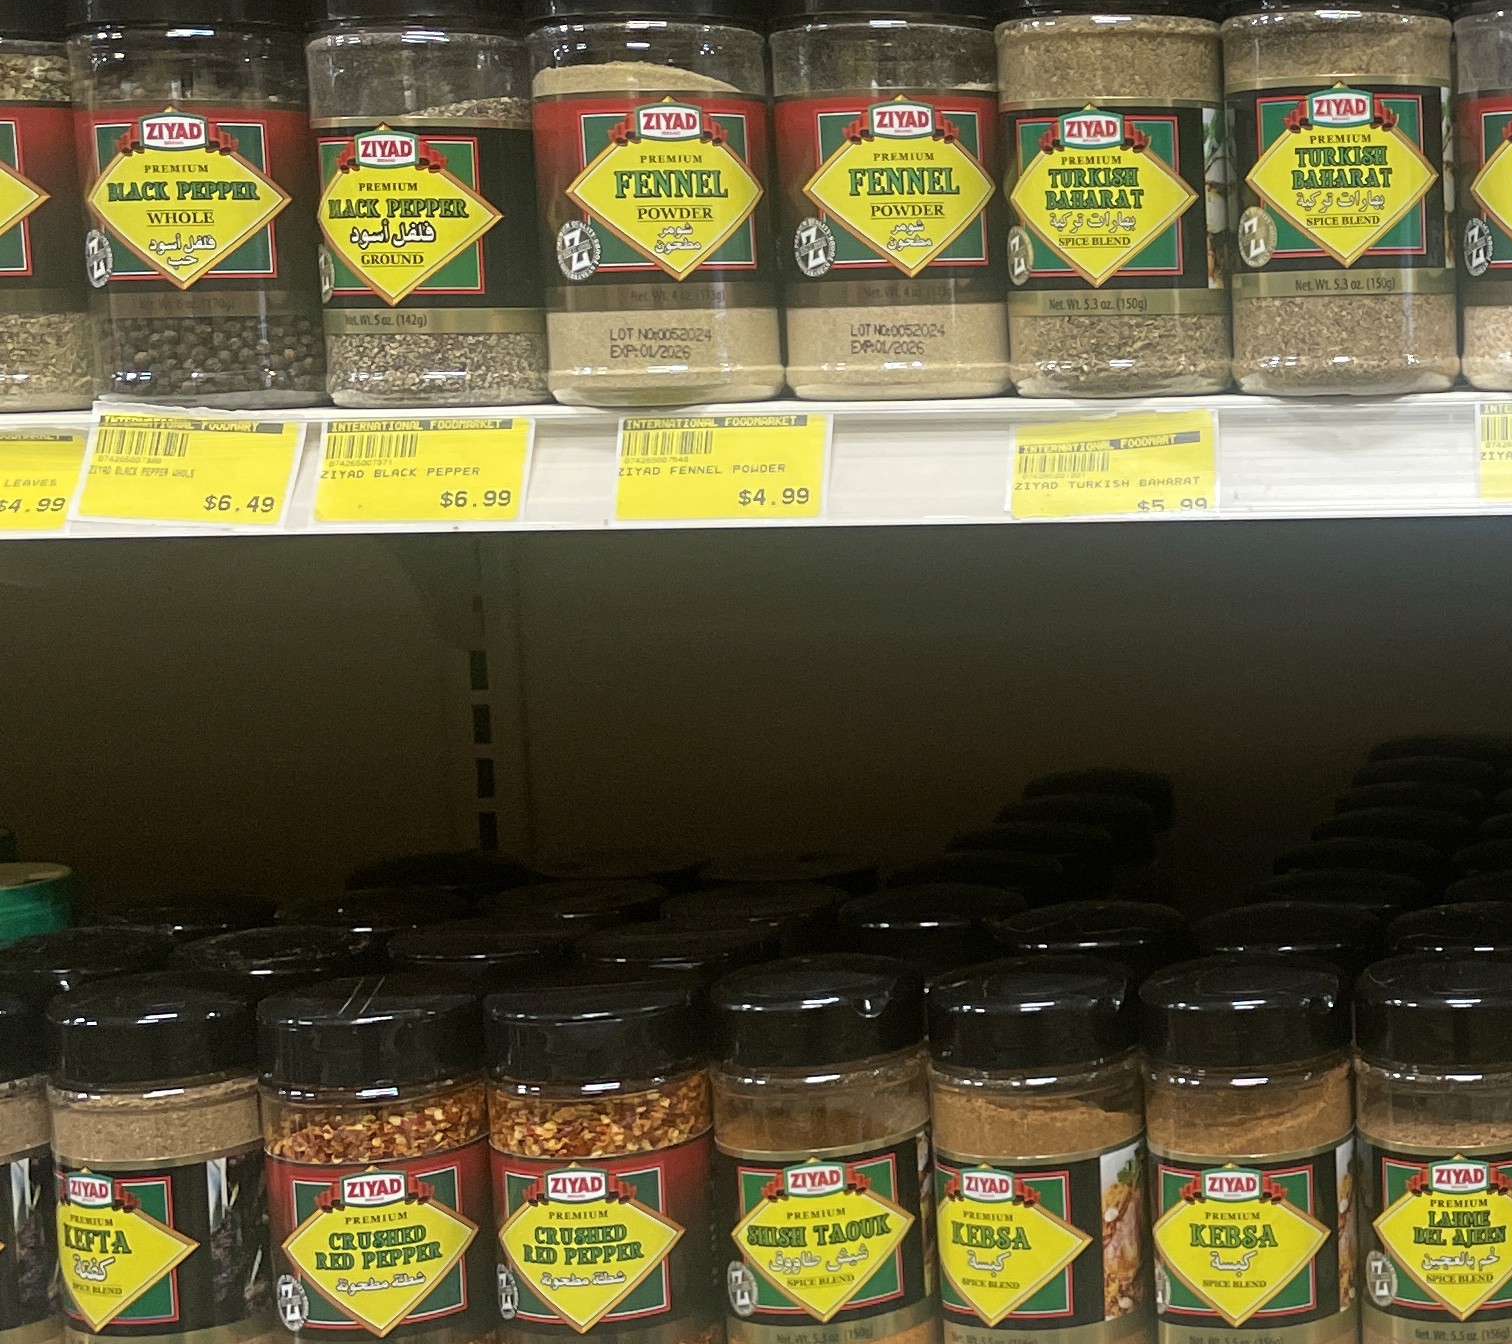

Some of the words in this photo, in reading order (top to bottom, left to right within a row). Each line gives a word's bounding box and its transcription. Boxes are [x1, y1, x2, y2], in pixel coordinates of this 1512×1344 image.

[144, 120, 203, 141] ZIYAD
[144, 164, 209, 174] PREMIUM
[1047, 167, 1139, 189] TURKISH
[107, 181, 169, 202] BLACK
[176, 181, 260, 202] PEPPER
[613, 169, 729, 199] FENNEL
[1044, 188, 1144, 210] BAHARAT
[146, 211, 215, 225] WHOLE
[637, 206, 714, 222] POWDER
[349, 219, 390, 247] أسود
[392, 221, 437, 247] فلفل
[609, 328, 633, 342] LOT
[204, 494, 275, 513] $6.49
[439, 489, 512, 509] $6.99
[738, 487, 810, 507] $4.99
[346, 1176, 403, 1199] ZIYAD
[64, 1225, 132, 1254] KEFTA
[327, 1227, 427, 1251] CRUSHED
[746, 1225, 807, 1247] SHISH
[813, 1214, 891, 1243] TAOUK
[1189, 1224, 1279, 1249] KEBSA
[314, 1252, 354, 1270] RED
[362, 1242, 444, 1270] PEPPER
